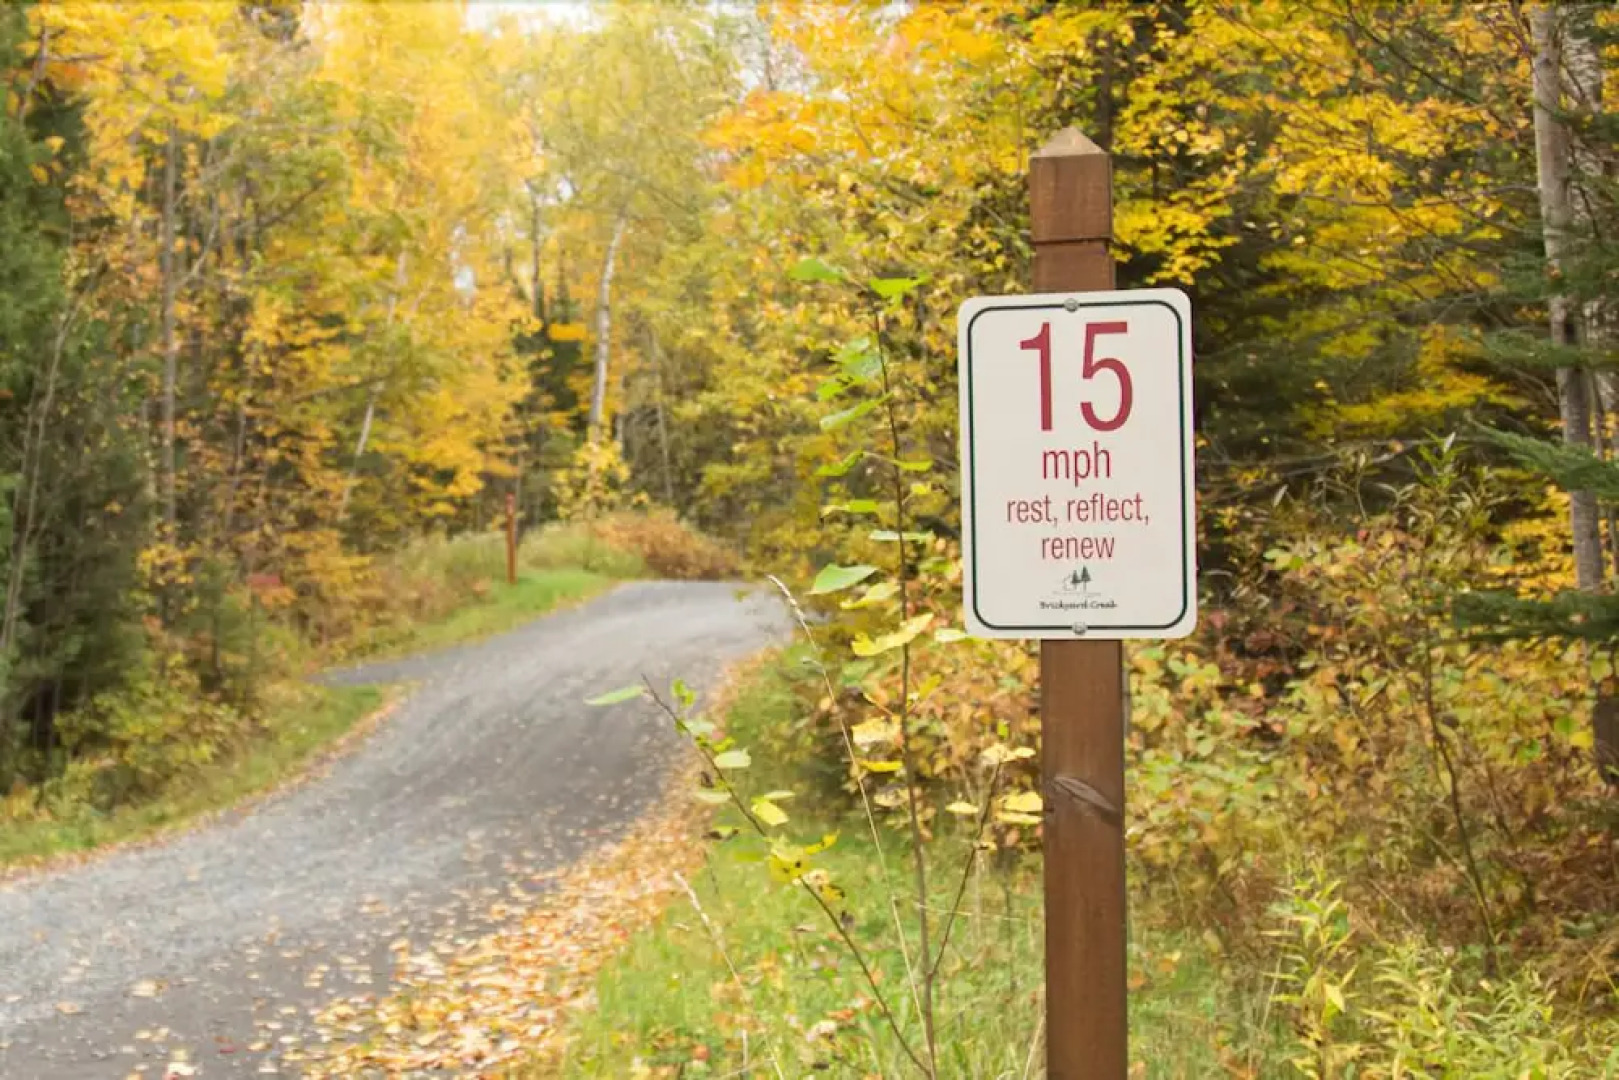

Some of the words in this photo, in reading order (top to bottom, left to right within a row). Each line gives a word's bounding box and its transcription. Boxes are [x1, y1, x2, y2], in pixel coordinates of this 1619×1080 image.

[1019, 321, 1133, 432] 15
[1042, 441, 1111, 487] mph
[1007, 495, 1058, 527] rest,
[1067, 492, 1149, 526] reflect,
[1041, 535, 1115, 560] renew
